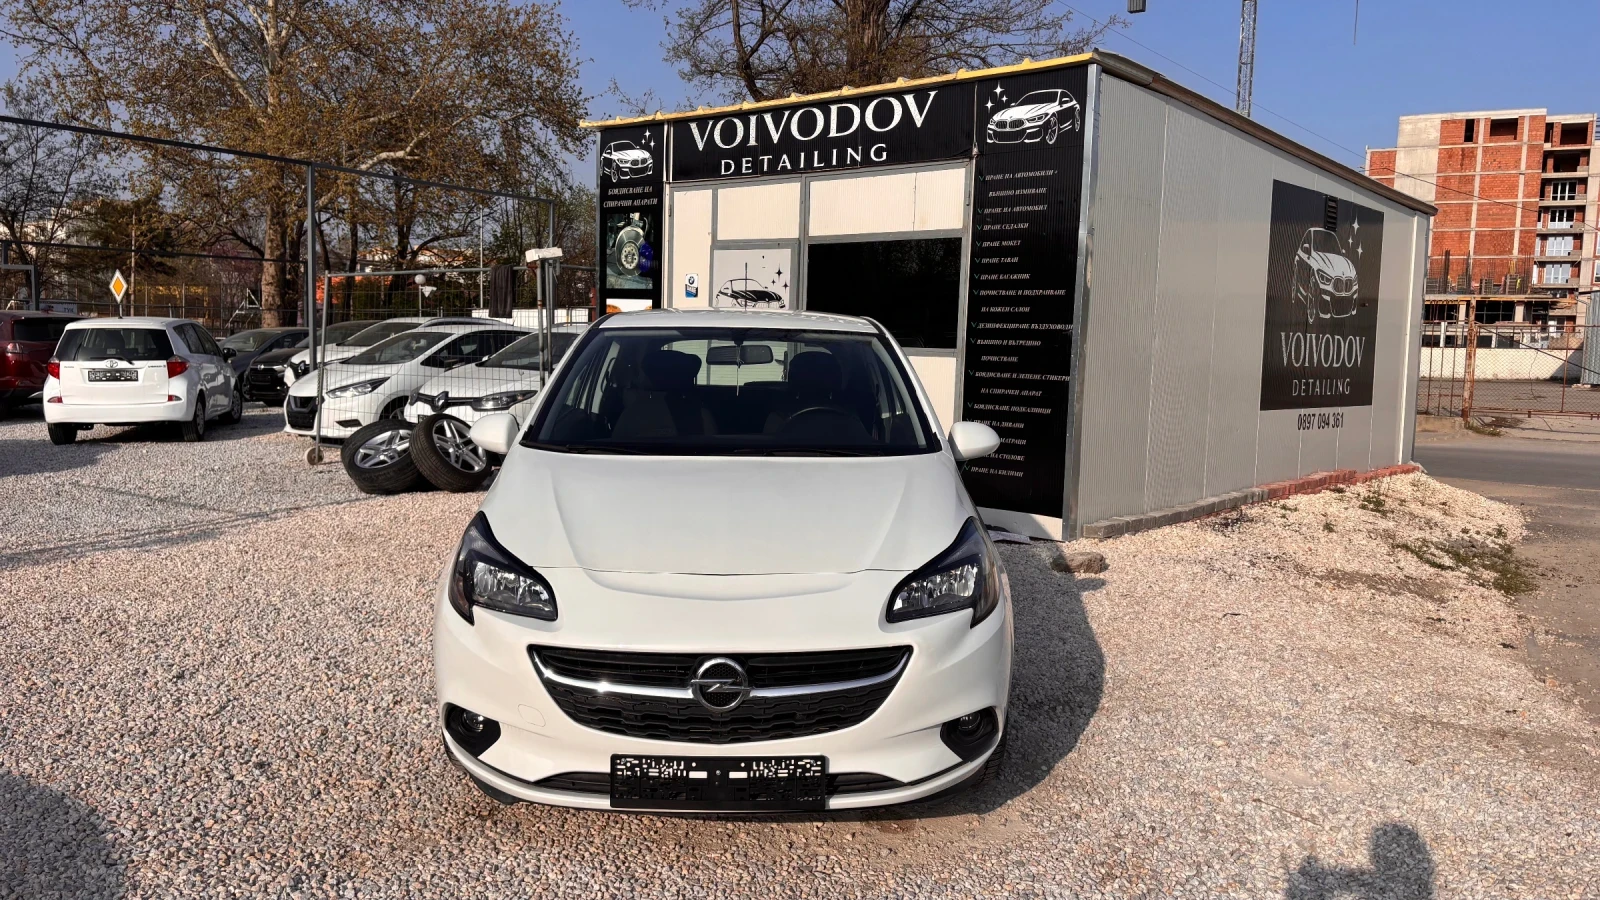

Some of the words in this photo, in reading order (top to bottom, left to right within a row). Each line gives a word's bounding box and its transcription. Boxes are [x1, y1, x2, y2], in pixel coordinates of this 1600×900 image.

[688, 91, 938, 151] VOIVODOV
[720, 143, 888, 176] DETAILING
[985, 173, 1004, 181] ПРАНЕ
[1014, 170, 1053, 178] АВТОМОБИЛИ
[608, 186, 644, 195] БОЯДИСВАНЕ
[1015, 187, 1047, 195] ИЗМИВАНЕ
[633, 198, 658, 206] АПАРАТИ
[1012, 204, 1047, 212] АВТОМОБИЛ
[1002, 222, 1029, 230] СЕДАЛКИ
[1281, 332, 1365, 367] VOIVODOV
[975, 371, 1012, 379] БОЯДИСВАНЕ
[1292, 378, 1351, 396] DETAILING
[973, 403, 1010, 411] БОЯДИСВАНЕ
[1000, 421, 1025, 429] ДИВАНИ
[1297, 413, 1316, 431] 0897
[1317, 413, 1330, 430] 094
[1331, 412, 1344, 428] 361
[999, 453, 1025, 461] СТОЛОВЕ
[998, 469, 1024, 477] КИЛИМИ
